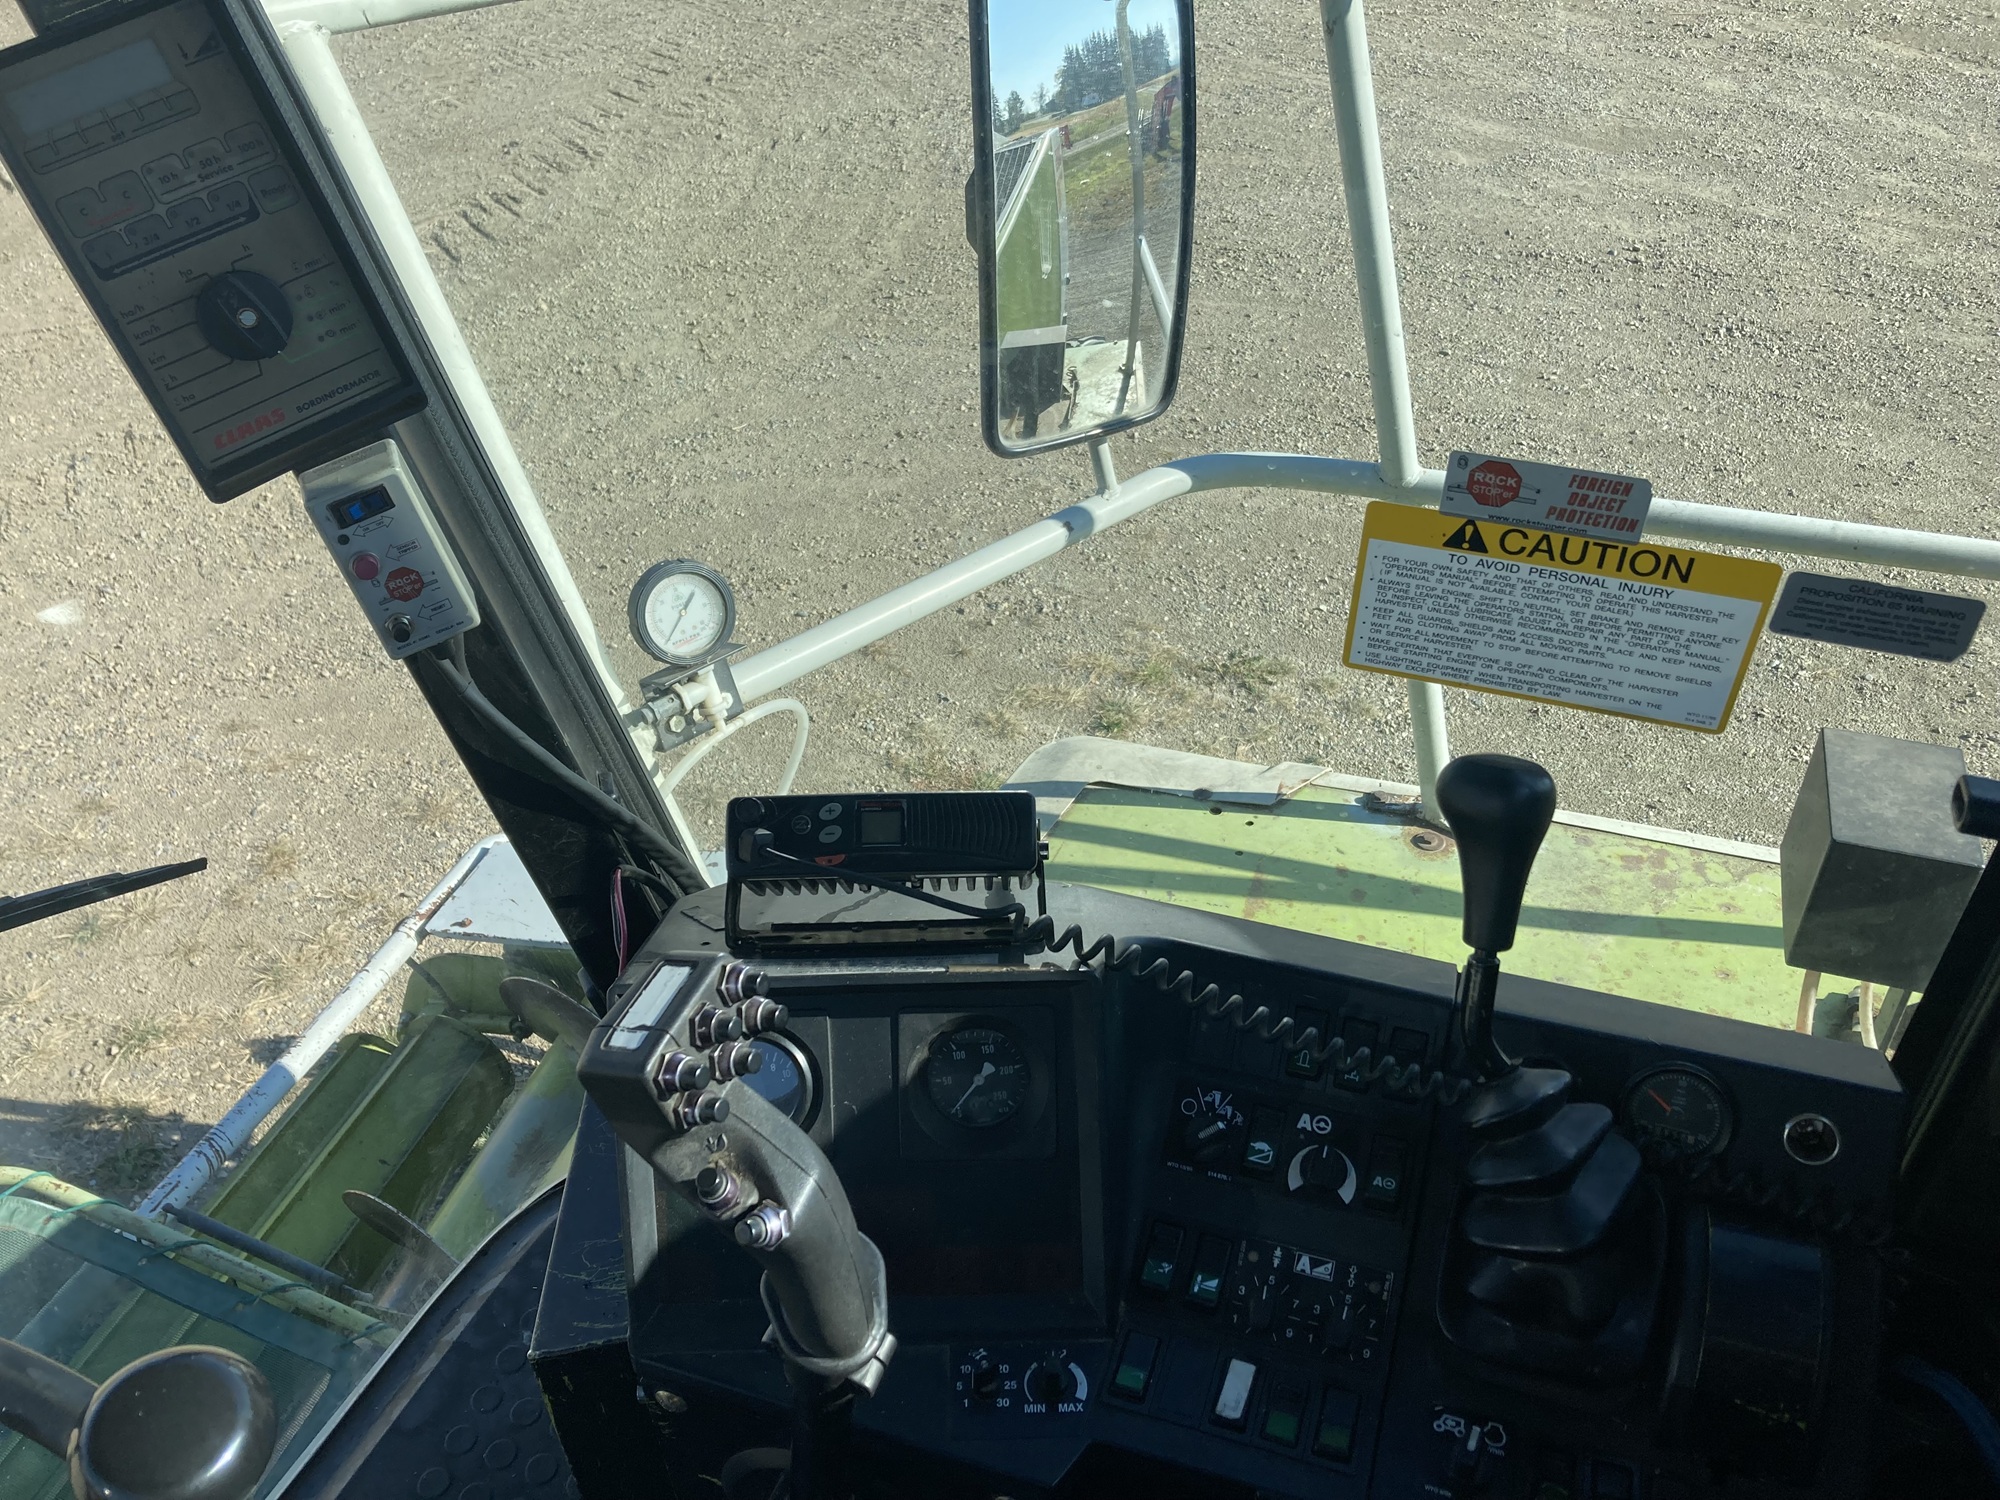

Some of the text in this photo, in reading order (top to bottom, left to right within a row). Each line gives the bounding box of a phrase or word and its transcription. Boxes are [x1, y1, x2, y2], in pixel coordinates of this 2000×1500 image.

[198, 164, 234, 183] Service
[133, 324, 161, 340] km/h
[214, 370, 382, 450] CLAAS BORDINFORMATOR
[1473, 470, 1518, 487] ROCK
[1568, 473, 1633, 497] FOREIGN
[1566, 491, 1626, 514] OBJECT
[1487, 513, 1587, 535] www.rockstopper.com
[1545, 505, 1639, 533] PROTECTION
[1495, 526, 1696, 584] CAUTION
[388, 572, 419, 590] ROCK
[1447, 553, 1675, 599] TO AVOID PERSONAL INJURY
[1381, 555, 1400, 563] FOR
[1403, 559, 1428, 568] YOUR
[1430, 563, 1453, 572] OWN
[1455, 567, 1489, 578] SAFETY
[1491, 573, 1512, 582] AND
[1514, 577, 1538, 586] THAT
[1540, 581, 1554, 589] OF
[1598, 591, 1625, 601] READ
[1627, 596, 1648, 605] AND
[1650, 600, 1714, 615] UNDERSTAND
[1716, 611, 1735, 619] THE
[1395, 571, 1432, 582] MANUAL
[1446, 580, 1466, 588] NOT
[1519, 592, 1562, 604] CONTACT
[1564, 599, 1591, 609] YOUR
[1847, 584, 1924, 604] CALIFORNIA
[1481, 579, 1518, 590] BEFORE
[1519, 585, 1576, 600] ATTEMPTING
[1594, 597, 1637, 610] OPERATE
[1639, 605, 1662, 614] THIS
[1664, 609, 1719, 623] HARVESTER
[1799, 586, 1885, 607] PROPOSITION
[1886, 600, 1902, 610] 65
[1905, 603, 1966, 621] WARNING
[1377, 577, 1411, 588] ALWAYS
[1414, 584, 1438, 593] STOP
[1478, 595, 1503, 604] SHIFT
[1507, 599, 1520, 607] TO
[1568, 610, 1586, 618] SET
[1589, 614, 1620, 624] BRAKE
[1622, 619, 1644, 628] AND
[1646, 623, 1685, 635] REMOVE
[1688, 630, 1718, 641] START
[1720, 636, 1740, 644] KEY
[1372, 606, 1395, 615] KEEP
[1397, 610, 1414, 618] ALL
[1457, 621, 1494, 632] SHIELDS
[1496, 628, 1516, 636] AND
[1518, 631, 1555, 643] ACCESS
[1557, 638, 1589, 649] DOORS
[1605, 647, 1635, 657] PLACE
[1637, 652, 1658, 661] AND
[1660, 656, 1685, 666] KEEP
[1384, 630, 1420, 641] SERVICE
[1366, 642, 1399, 653] BEFORE
[1402, 649, 1443, 661] STARTING
[1445, 656, 1477, 667] ENGINE
[1479, 662, 1493, 670] OR
[1496, 665, 1544, 679] OPERATING
[1364, 657, 1402, 668] HIGHWAY
[1404, 664, 1437, 675] EXCEPT
[1439, 670, 1470, 681] WHERE
[1472, 677, 1524, 691] PROHIBITED
[1364, 651, 1663, 710] USE LIGHTING EQUIPMENT WHEN TRANSPORTING HARVESTER ON THE
[952, 1050, 966, 1060] 100
[981, 1044, 994, 1055] 150
[770, 1063, 792, 1078] 8 10
[1000, 1065, 1014, 1075] 200
[942, 1076, 952, 1086] 50
[1268, 1275, 1276, 1285] 5
[1238, 1285, 1246, 1295] 3
[1292, 1299, 1300, 1309] 7
[1345, 1294, 1352, 1305] 5
[1313, 1304, 1320, 1315] 3
[1369, 1319, 1376, 1329] 7
[1286, 1328, 1293, 1338] 9
[1363, 1348, 1370, 1359] 9
[960, 1365, 971, 1374] 10
[957, 1381, 963, 1391] 5
[1004, 1380, 1018, 1390] 25
[996, 1398, 1010, 1408] 30
[1024, 1402, 1083, 1413] MIN MAX
